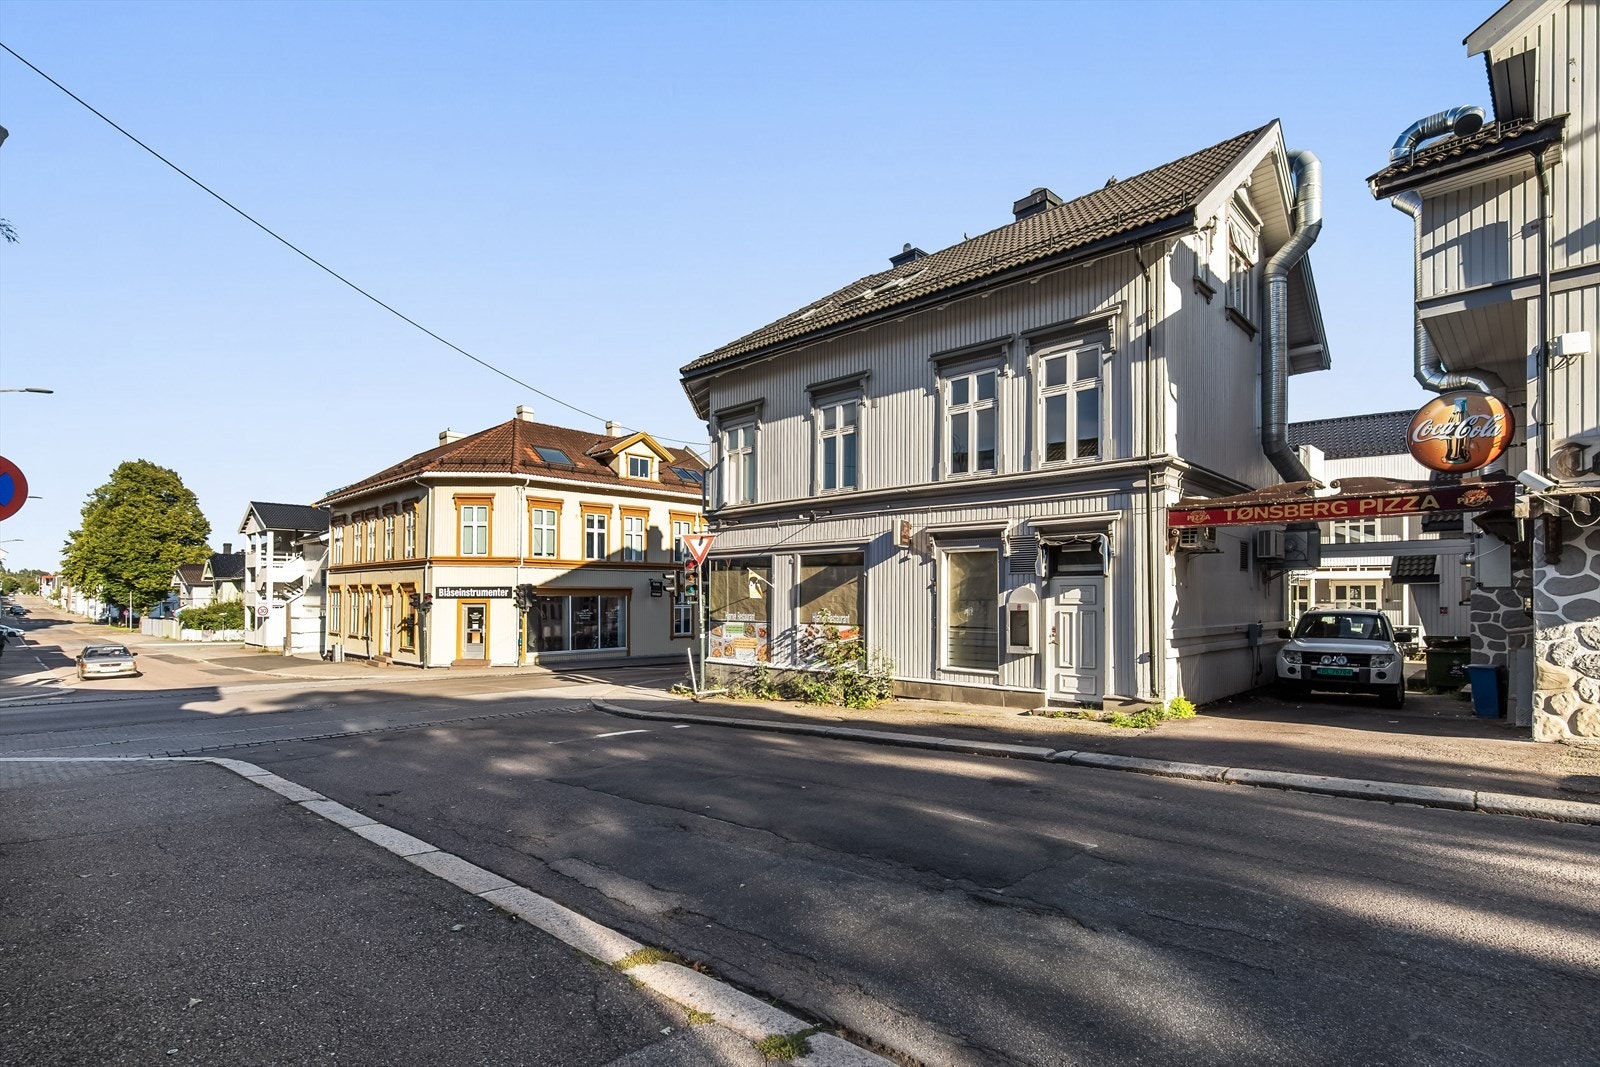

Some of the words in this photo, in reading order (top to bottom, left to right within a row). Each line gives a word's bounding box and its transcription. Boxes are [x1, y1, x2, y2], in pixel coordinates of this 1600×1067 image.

[1457, 493, 1494, 505] PIZZA
[1224, 500, 1348, 521] TØNSBERG
[1359, 494, 1440, 514] PIZZA
[1186, 512, 1211, 522] PIZZA
[438, 587, 509, 597] Blåseinstrumenter
